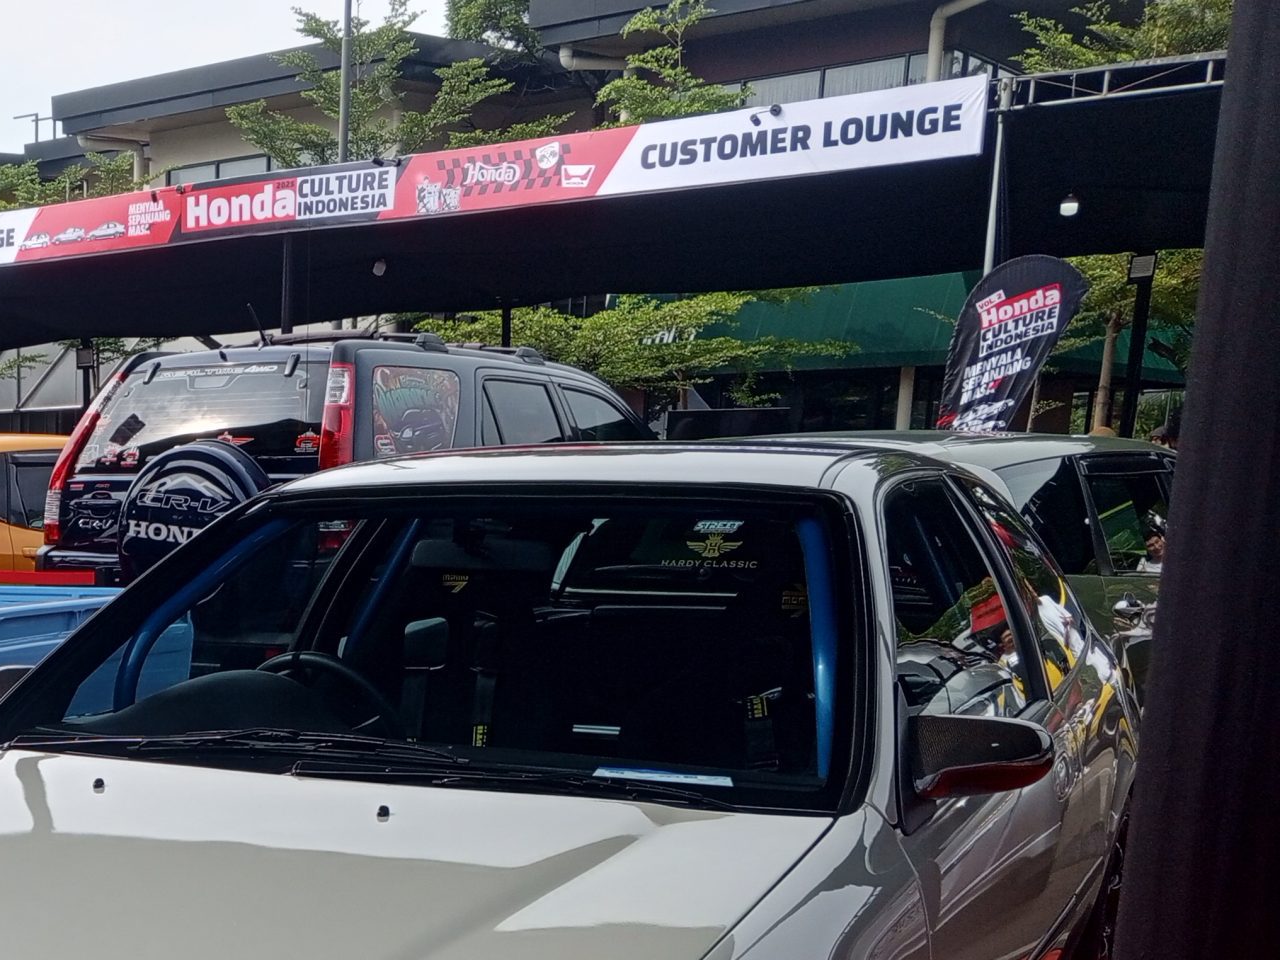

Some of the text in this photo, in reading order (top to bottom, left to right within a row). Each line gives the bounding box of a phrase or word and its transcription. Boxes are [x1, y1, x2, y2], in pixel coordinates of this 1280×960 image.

[640, 103, 963, 170] CUSTOMER LOUNGE
[298, 170, 389, 199] CULTURE
[464, 161, 520, 185] Honda
[128, 200, 164, 215] MENYALA
[128, 210, 171, 226] SEPANJANG
[186, 183, 295, 229] Honda
[297, 193, 388, 217] INDONESIA
[980, 288, 1061, 328] Honda
[980, 321, 1055, 355] INDONESIA
[981, 305, 1058, 342] CULTURE
[962, 357, 1032, 393] SEPANJANG
[964, 347, 1022, 379] MENYALA
[136, 491, 231, 514] CR-V
[128, 519, 202, 544] HON
[661, 560, 759, 569] HARDY CLASSIC
